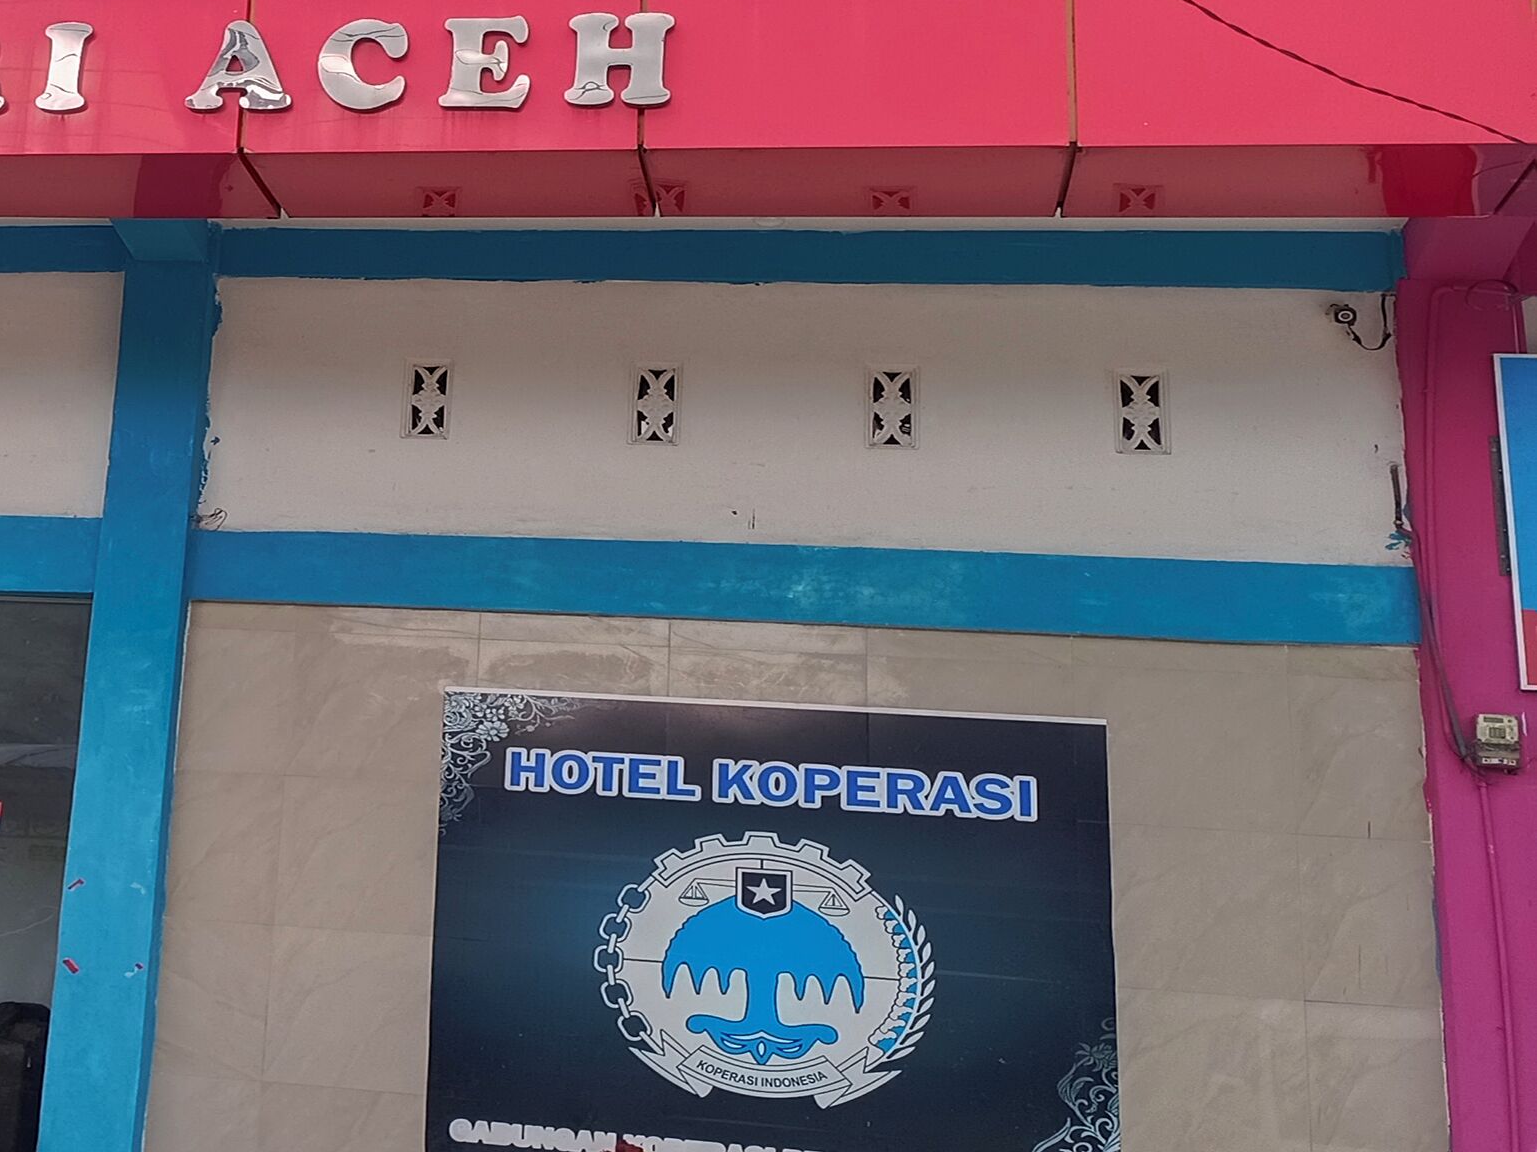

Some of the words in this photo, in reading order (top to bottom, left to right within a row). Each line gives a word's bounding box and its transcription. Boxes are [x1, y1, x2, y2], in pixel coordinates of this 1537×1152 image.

[183, 12, 676, 112] ACEH
[504, 748, 702, 802] HOTEL
[712, 757, 1039, 823] KOPERASI
[695, 1059, 758, 1087] KOPERASI
[760, 1070, 828, 1088] INDONESIA
